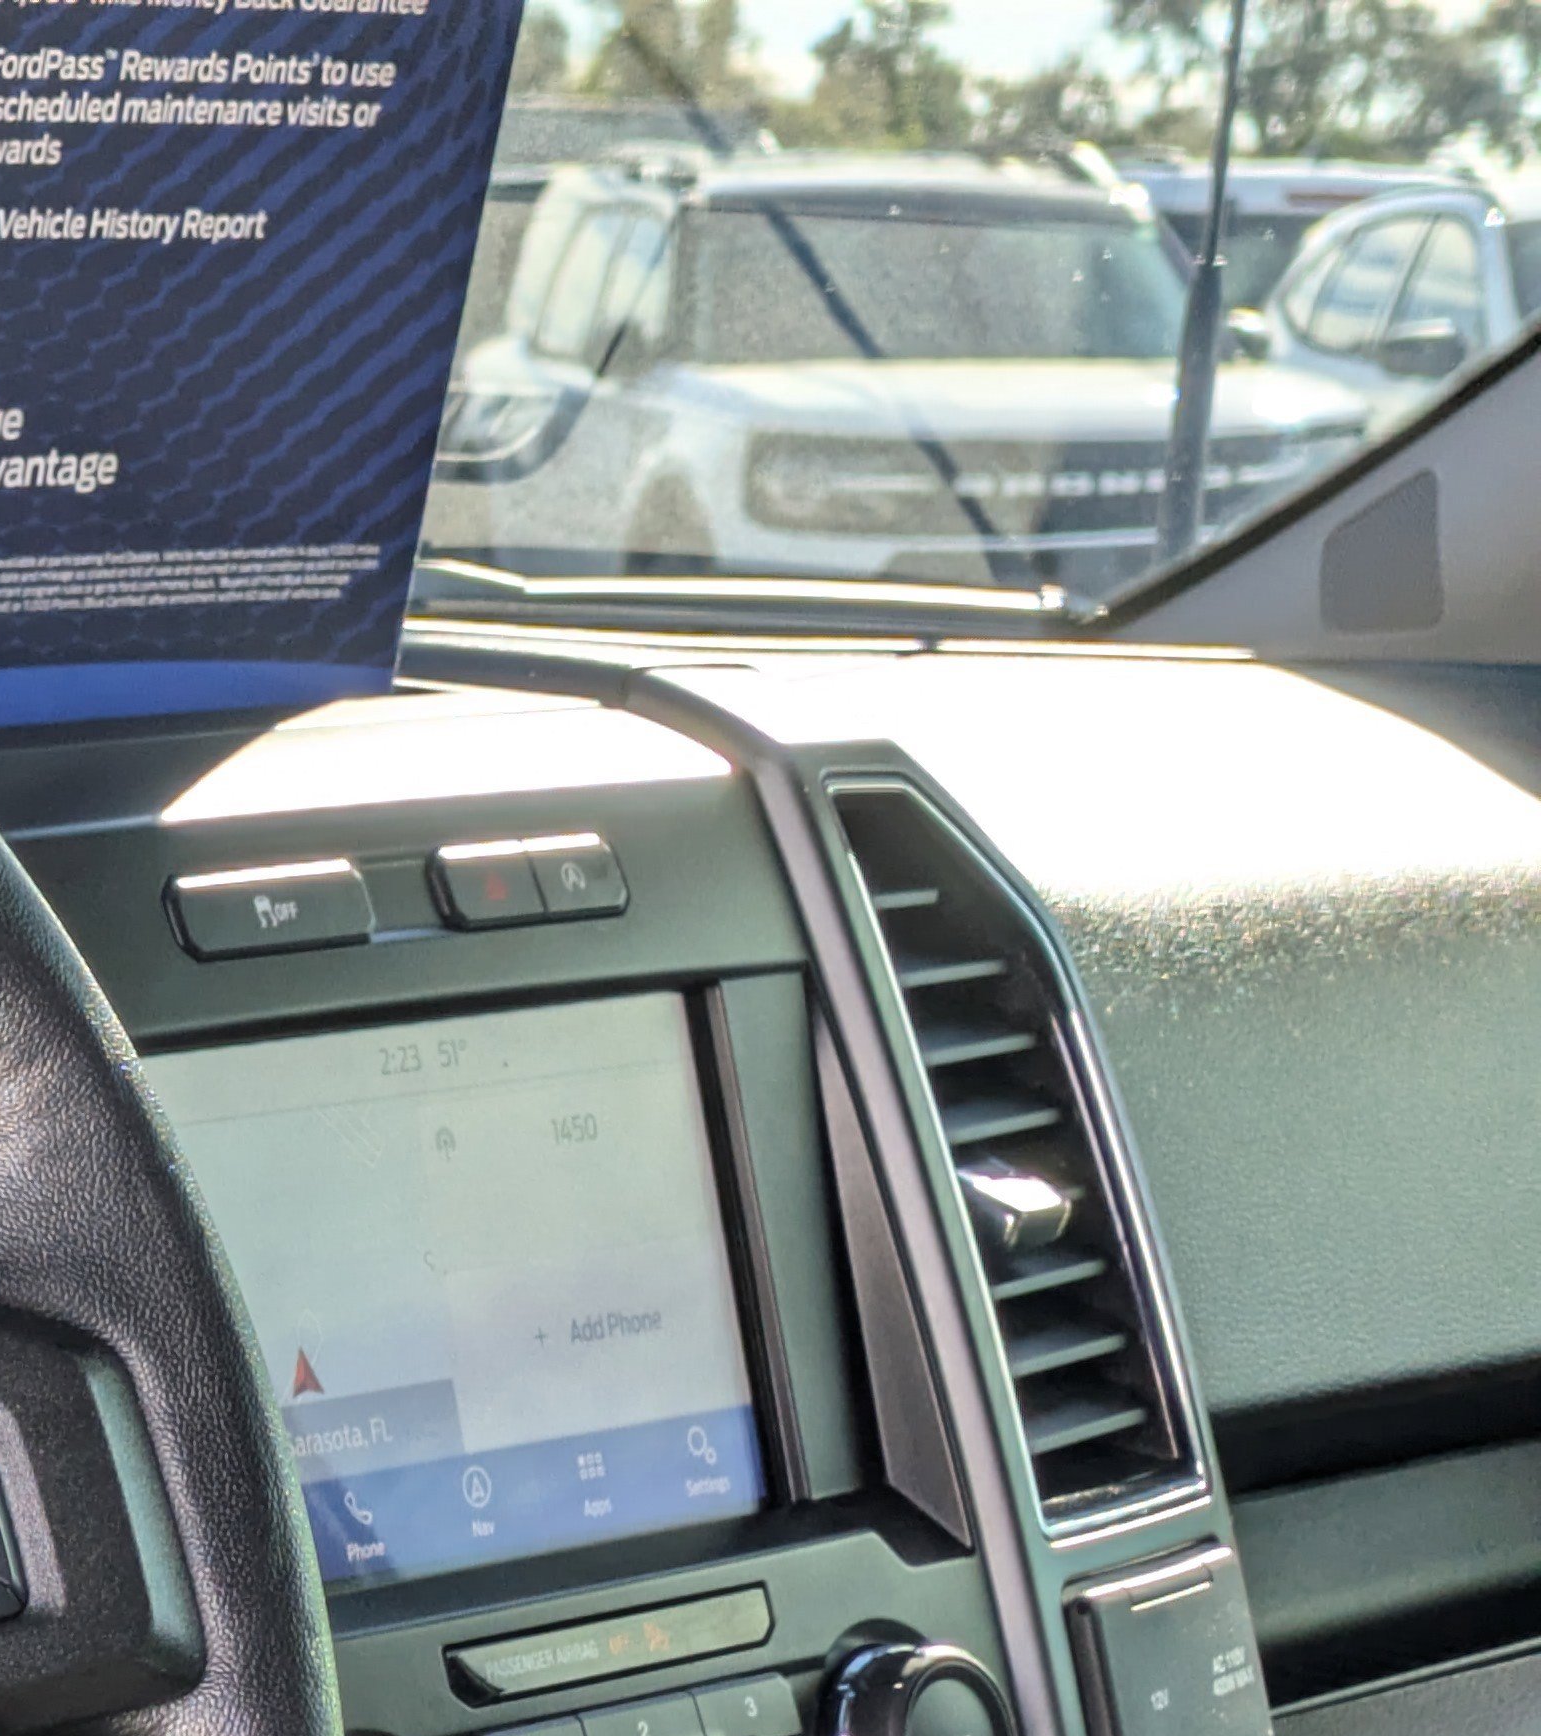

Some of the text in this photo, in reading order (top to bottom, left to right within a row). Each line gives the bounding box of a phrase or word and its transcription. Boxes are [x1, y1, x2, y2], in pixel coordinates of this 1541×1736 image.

[120, 50, 229, 83] Rewards
[321, 59, 348, 86] to
[350, 62, 397, 87] use
[121, 93, 283, 126] maintenance
[286, 97, 350, 127] visits
[353, 103, 383, 128] or
[89, 209, 180, 245] History
[181, 209, 268, 245] Report
[275, 902, 298, 921] OFF
[379, 1044, 422, 1075] 2:23
[551, 1113, 598, 1144] 1450
[570, 1310, 662, 1342] Add Phone
[472, 1520, 494, 1537] Nav
[346, 1542, 385, 1562] Phone
[744, 1696, 758, 1717] 3
